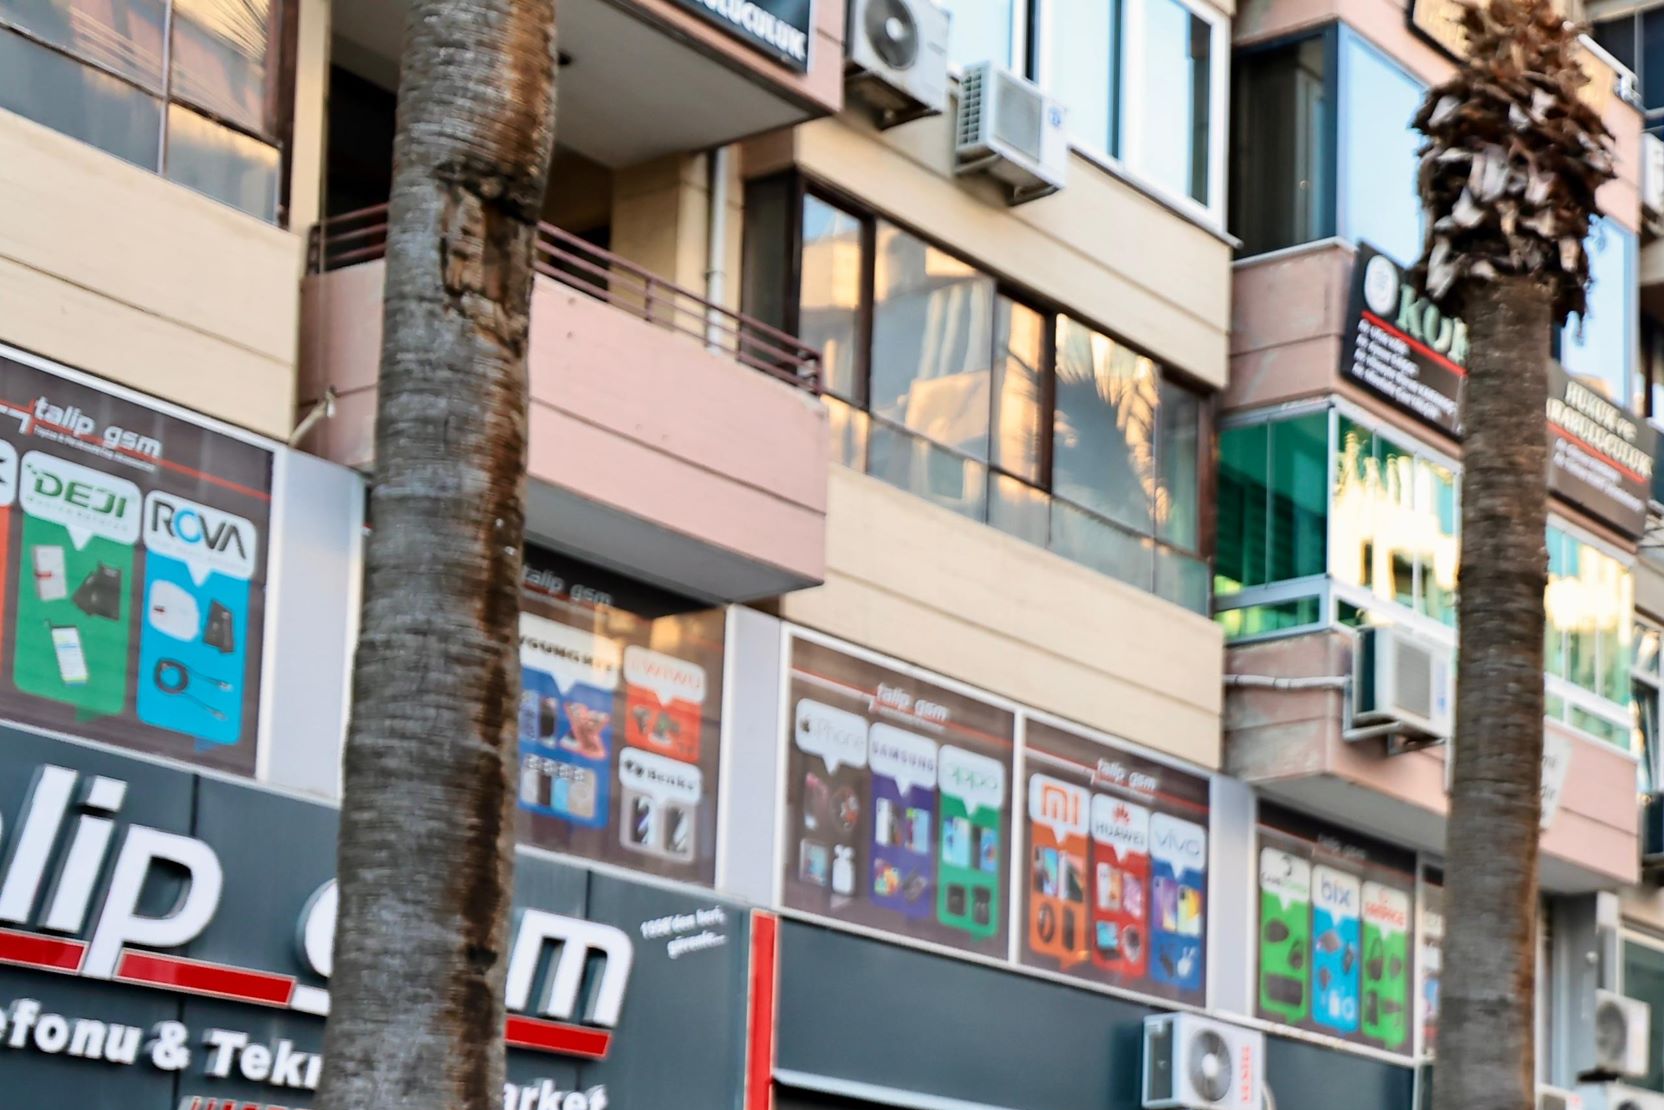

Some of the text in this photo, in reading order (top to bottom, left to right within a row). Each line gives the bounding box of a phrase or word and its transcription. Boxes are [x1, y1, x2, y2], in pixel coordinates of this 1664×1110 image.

[34, 396, 96, 438] talip
[103, 425, 162, 460] gsm
[33, 471, 127, 518] DEJI
[151, 498, 247, 560] ROVA
[521, 564, 565, 594] talip
[570, 583, 612, 606] gsm
[877, 682, 912, 710] talip
[914, 699, 949, 722] gsm
[871, 740, 935, 772] SAMSUNG
[1129, 771, 1158, 792] gsm
[1095, 820, 1146, 848] HUAWEI
[0, 763, 223, 981] lip
[0, 997, 142, 1066] fonu
[150, 1018, 190, 1072] &
